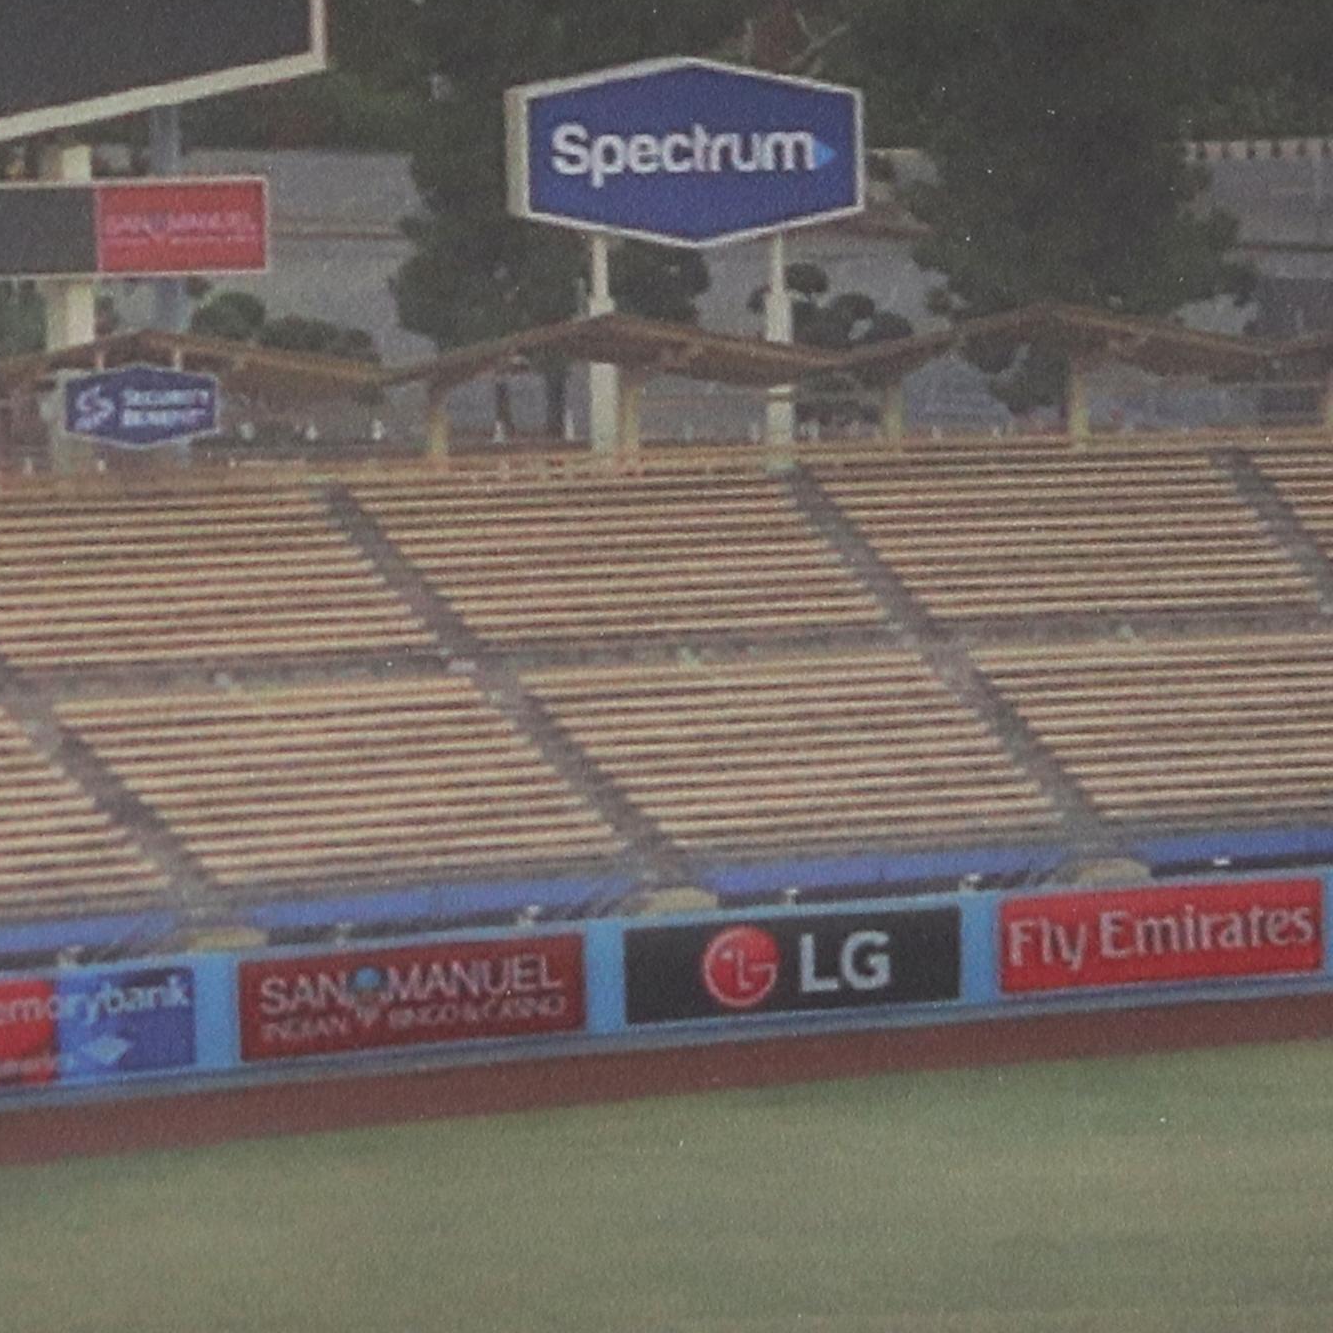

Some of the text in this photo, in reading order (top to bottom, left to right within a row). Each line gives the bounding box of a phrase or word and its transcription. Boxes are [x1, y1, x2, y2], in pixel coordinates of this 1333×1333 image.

[550, 121, 817, 189] Spectrum
[799, 931, 891, 993] LG
[1007, 903, 1315, 972] Fly Emirates
[259, 953, 563, 1016] SAN MANUEL
